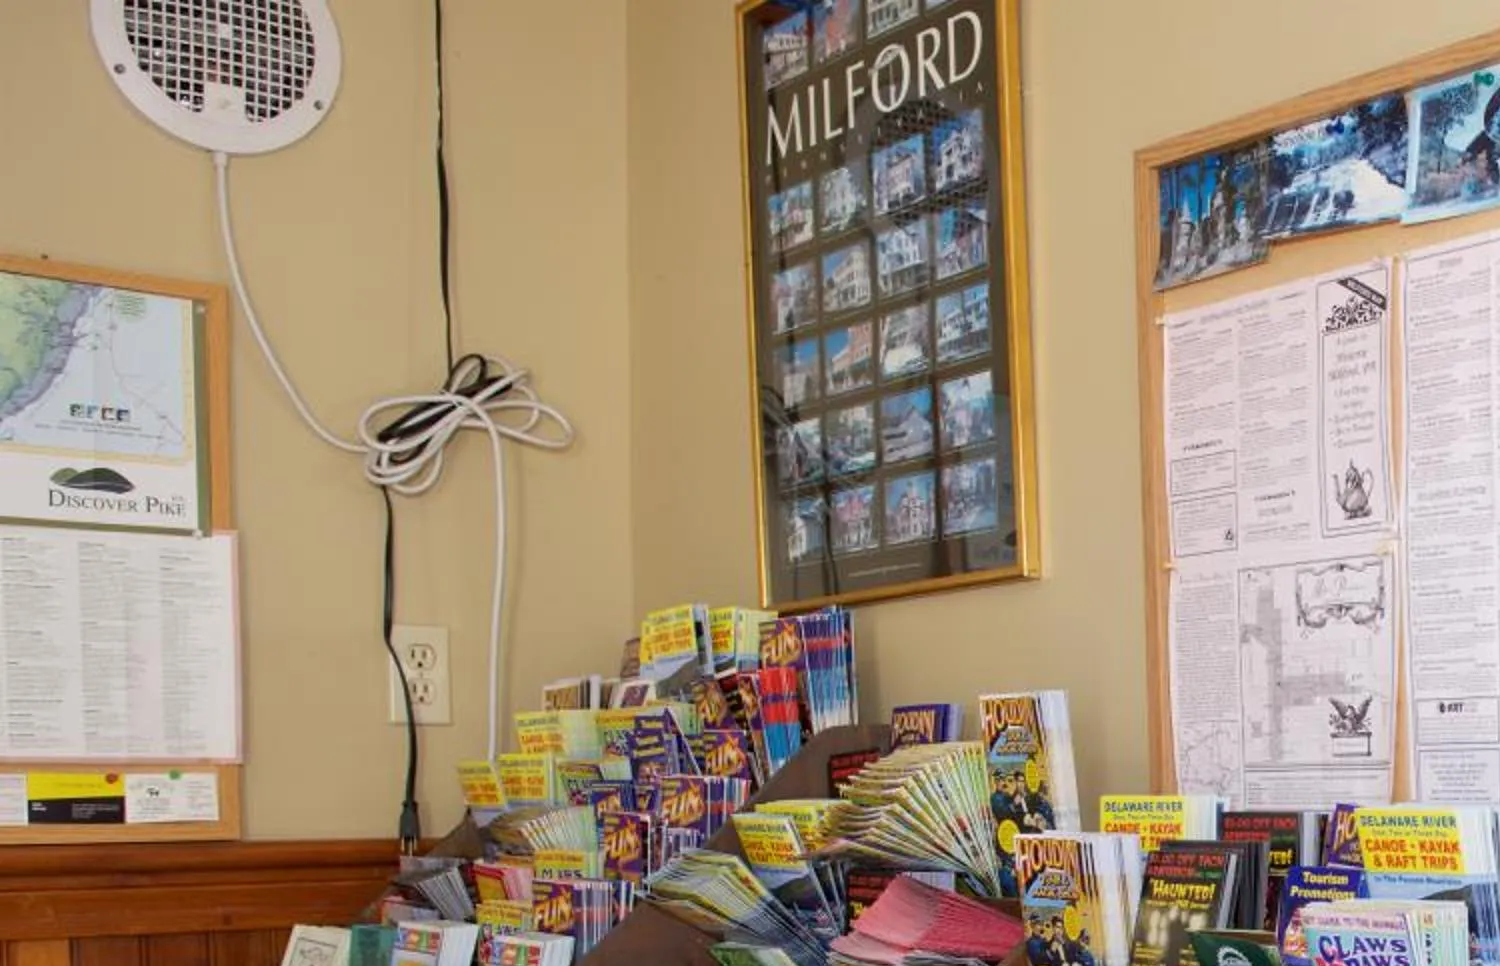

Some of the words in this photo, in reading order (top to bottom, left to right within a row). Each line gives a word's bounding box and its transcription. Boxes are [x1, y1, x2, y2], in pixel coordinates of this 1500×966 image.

[766, 11, 983, 165] MILFORD
[48, 489, 138, 513] DISCOVER
[1359, 815, 1420, 828] DELAWARE
[1422, 815, 1457, 829] RIVER
[1365, 838, 1407, 853] CANOE
[1419, 839, 1461, 854] KAYAK
[1386, 855, 1417, 869] RAFT
[1421, 855, 1458, 871] TRIPS
[1302, 871, 1349, 885] Tourism
[1290, 885, 1356, 901] Promotions
[1318, 935, 1408, 964] CLAWS
